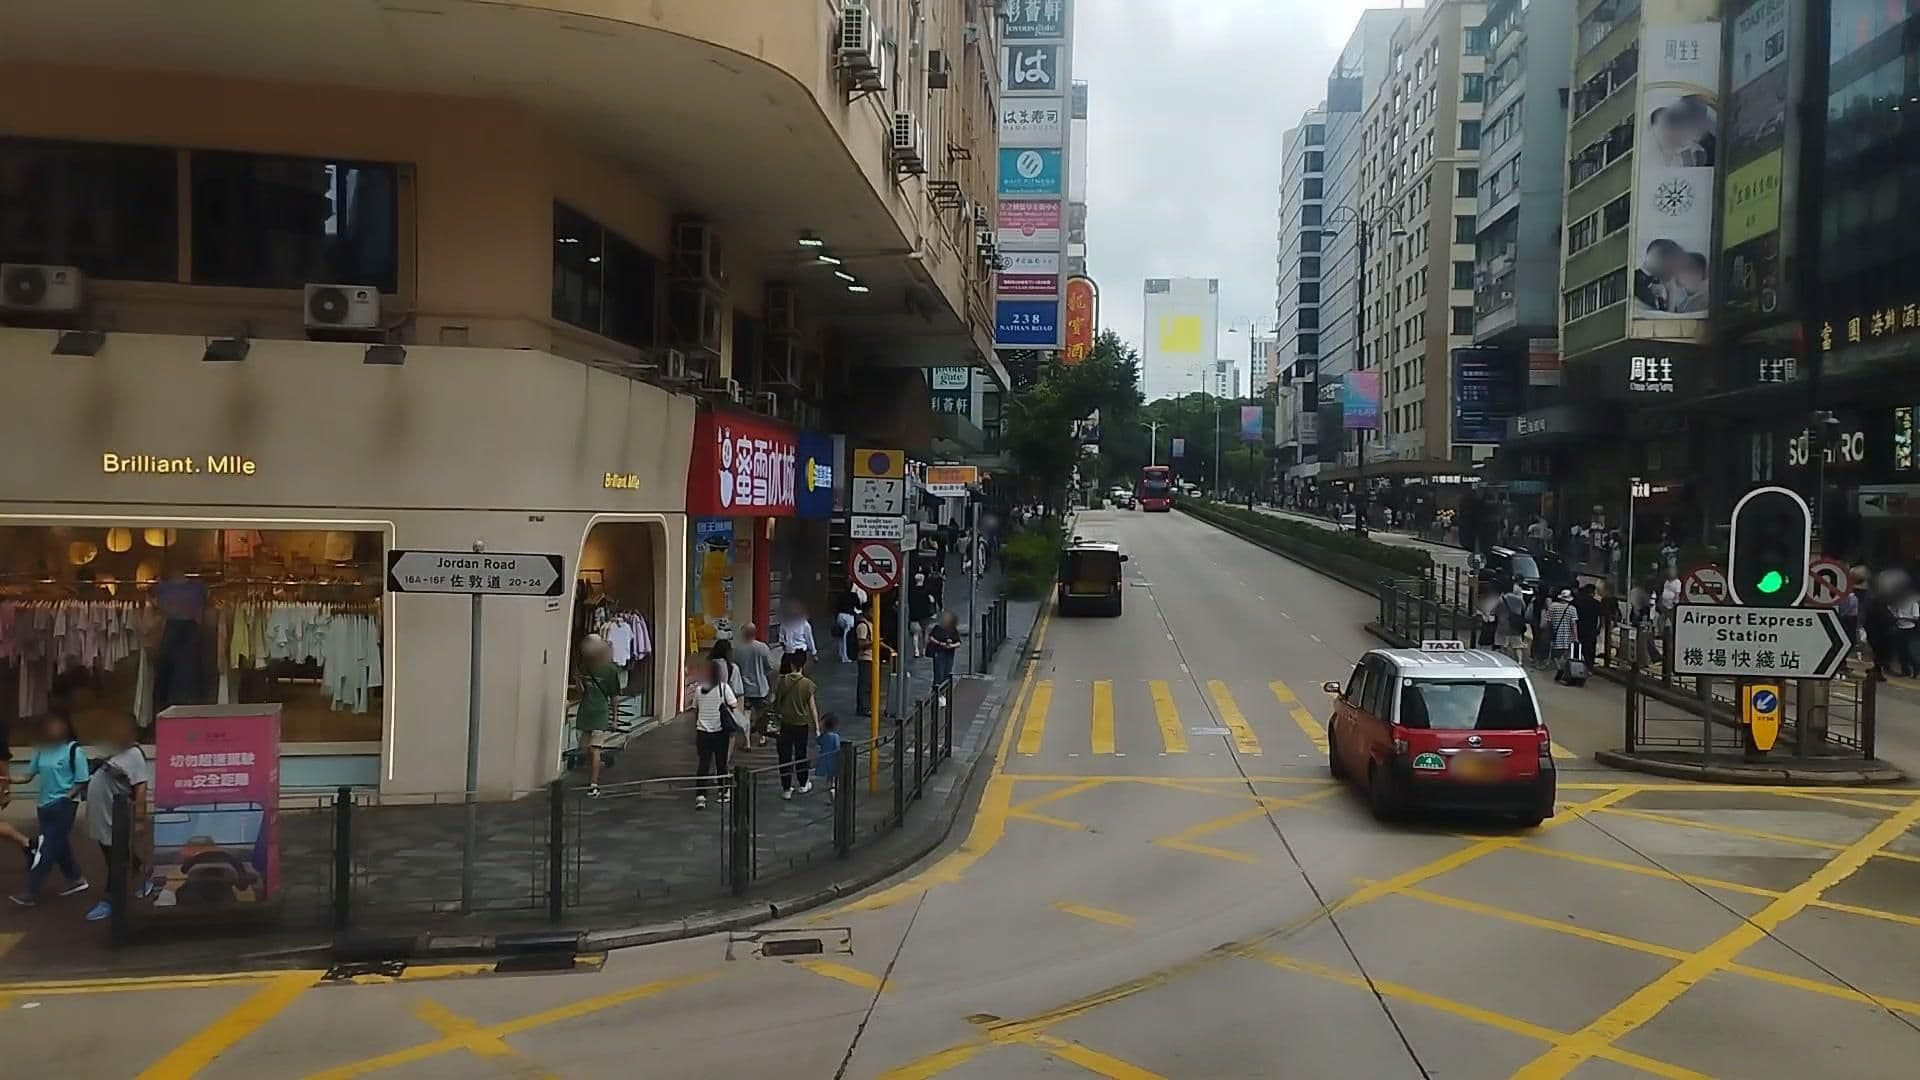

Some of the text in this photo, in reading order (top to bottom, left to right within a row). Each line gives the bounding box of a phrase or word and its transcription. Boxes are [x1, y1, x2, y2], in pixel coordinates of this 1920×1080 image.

[1664, 39, 1699, 61] 周生生
[1014, 49, 1049, 83] は
[1003, 110, 1058, 124] はま寿司
[1012, 314, 1041, 325] 238
[999, 324, 1030, 332] NATHAN
[1630, 357, 1673, 381] 周生生
[103, 452, 257, 475] Brilliant. Mlle
[735, 434, 796, 506] 蜜雪冰城
[886, 481, 894, 493] 7
[885, 500, 893, 512] 7
[436, 557, 516, 570] Jordan Road
[450, 574, 501, 589] 佐敦道
[1683, 611, 1813, 629] Airport Express
[1716, 629, 1778, 643] Station
[1426, 642, 1460, 650] TAXI
[1683, 647, 1800, 669] 機場快綫站
